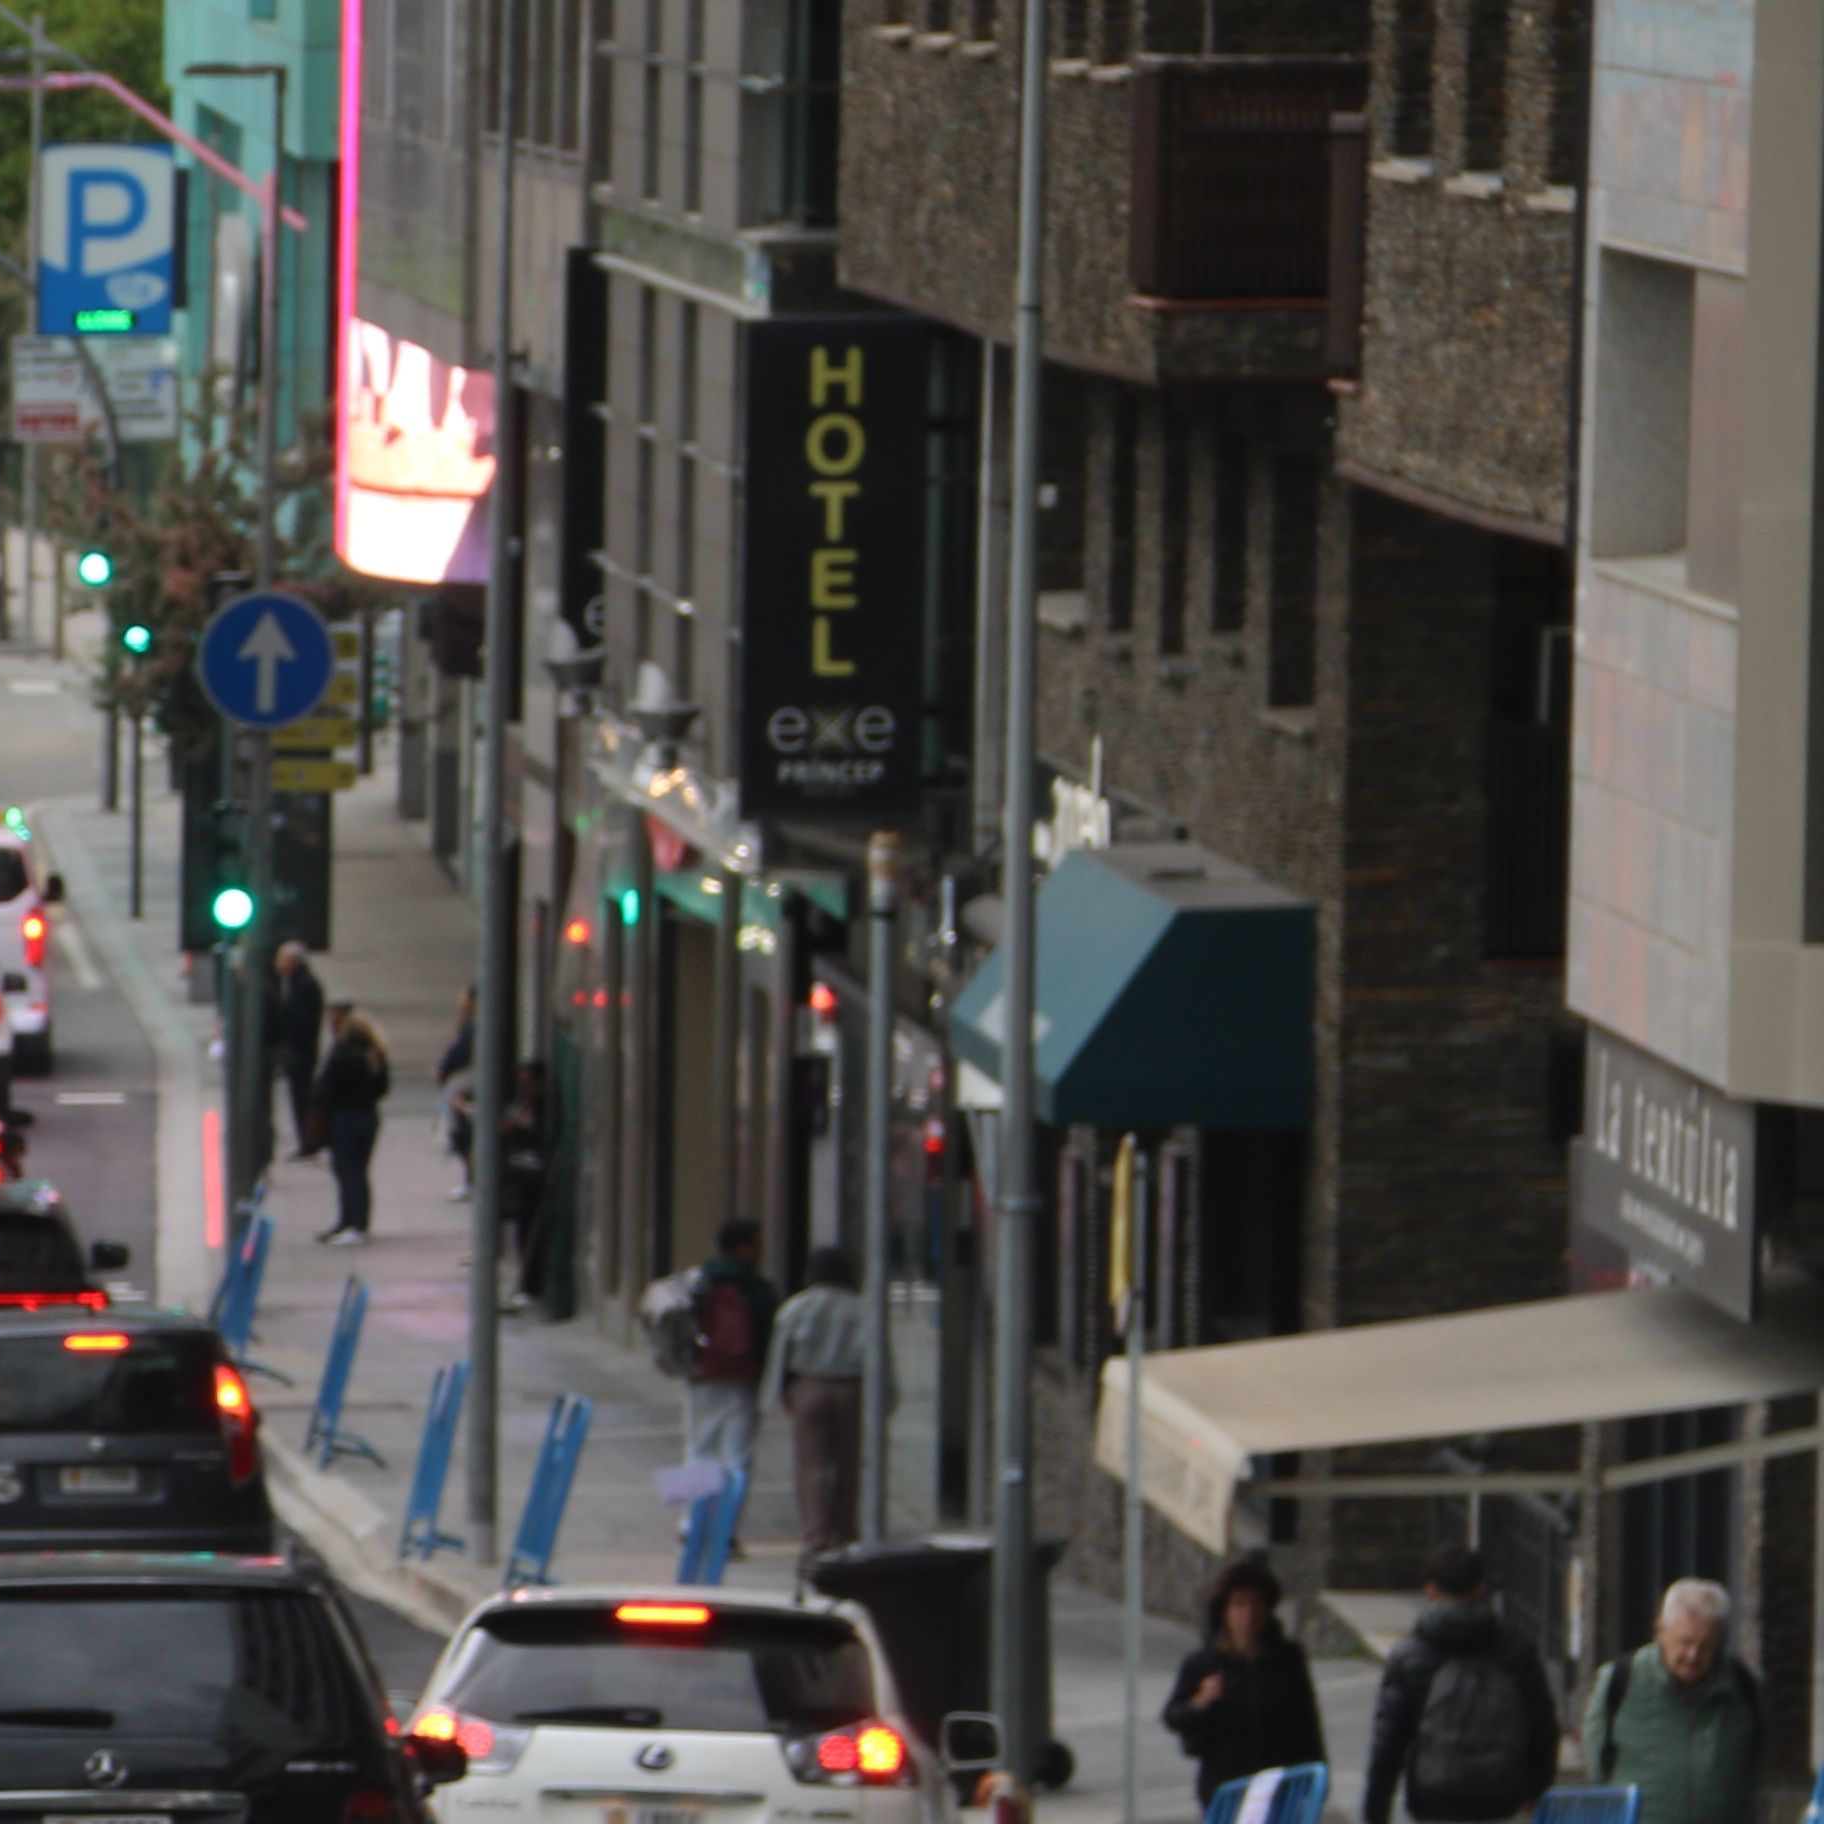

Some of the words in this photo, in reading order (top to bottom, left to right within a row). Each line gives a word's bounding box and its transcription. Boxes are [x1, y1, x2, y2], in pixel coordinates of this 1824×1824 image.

[68, 169, 147, 274] P
[805, 344, 867, 678] HOTEL
[767, 705, 896, 752] exe
